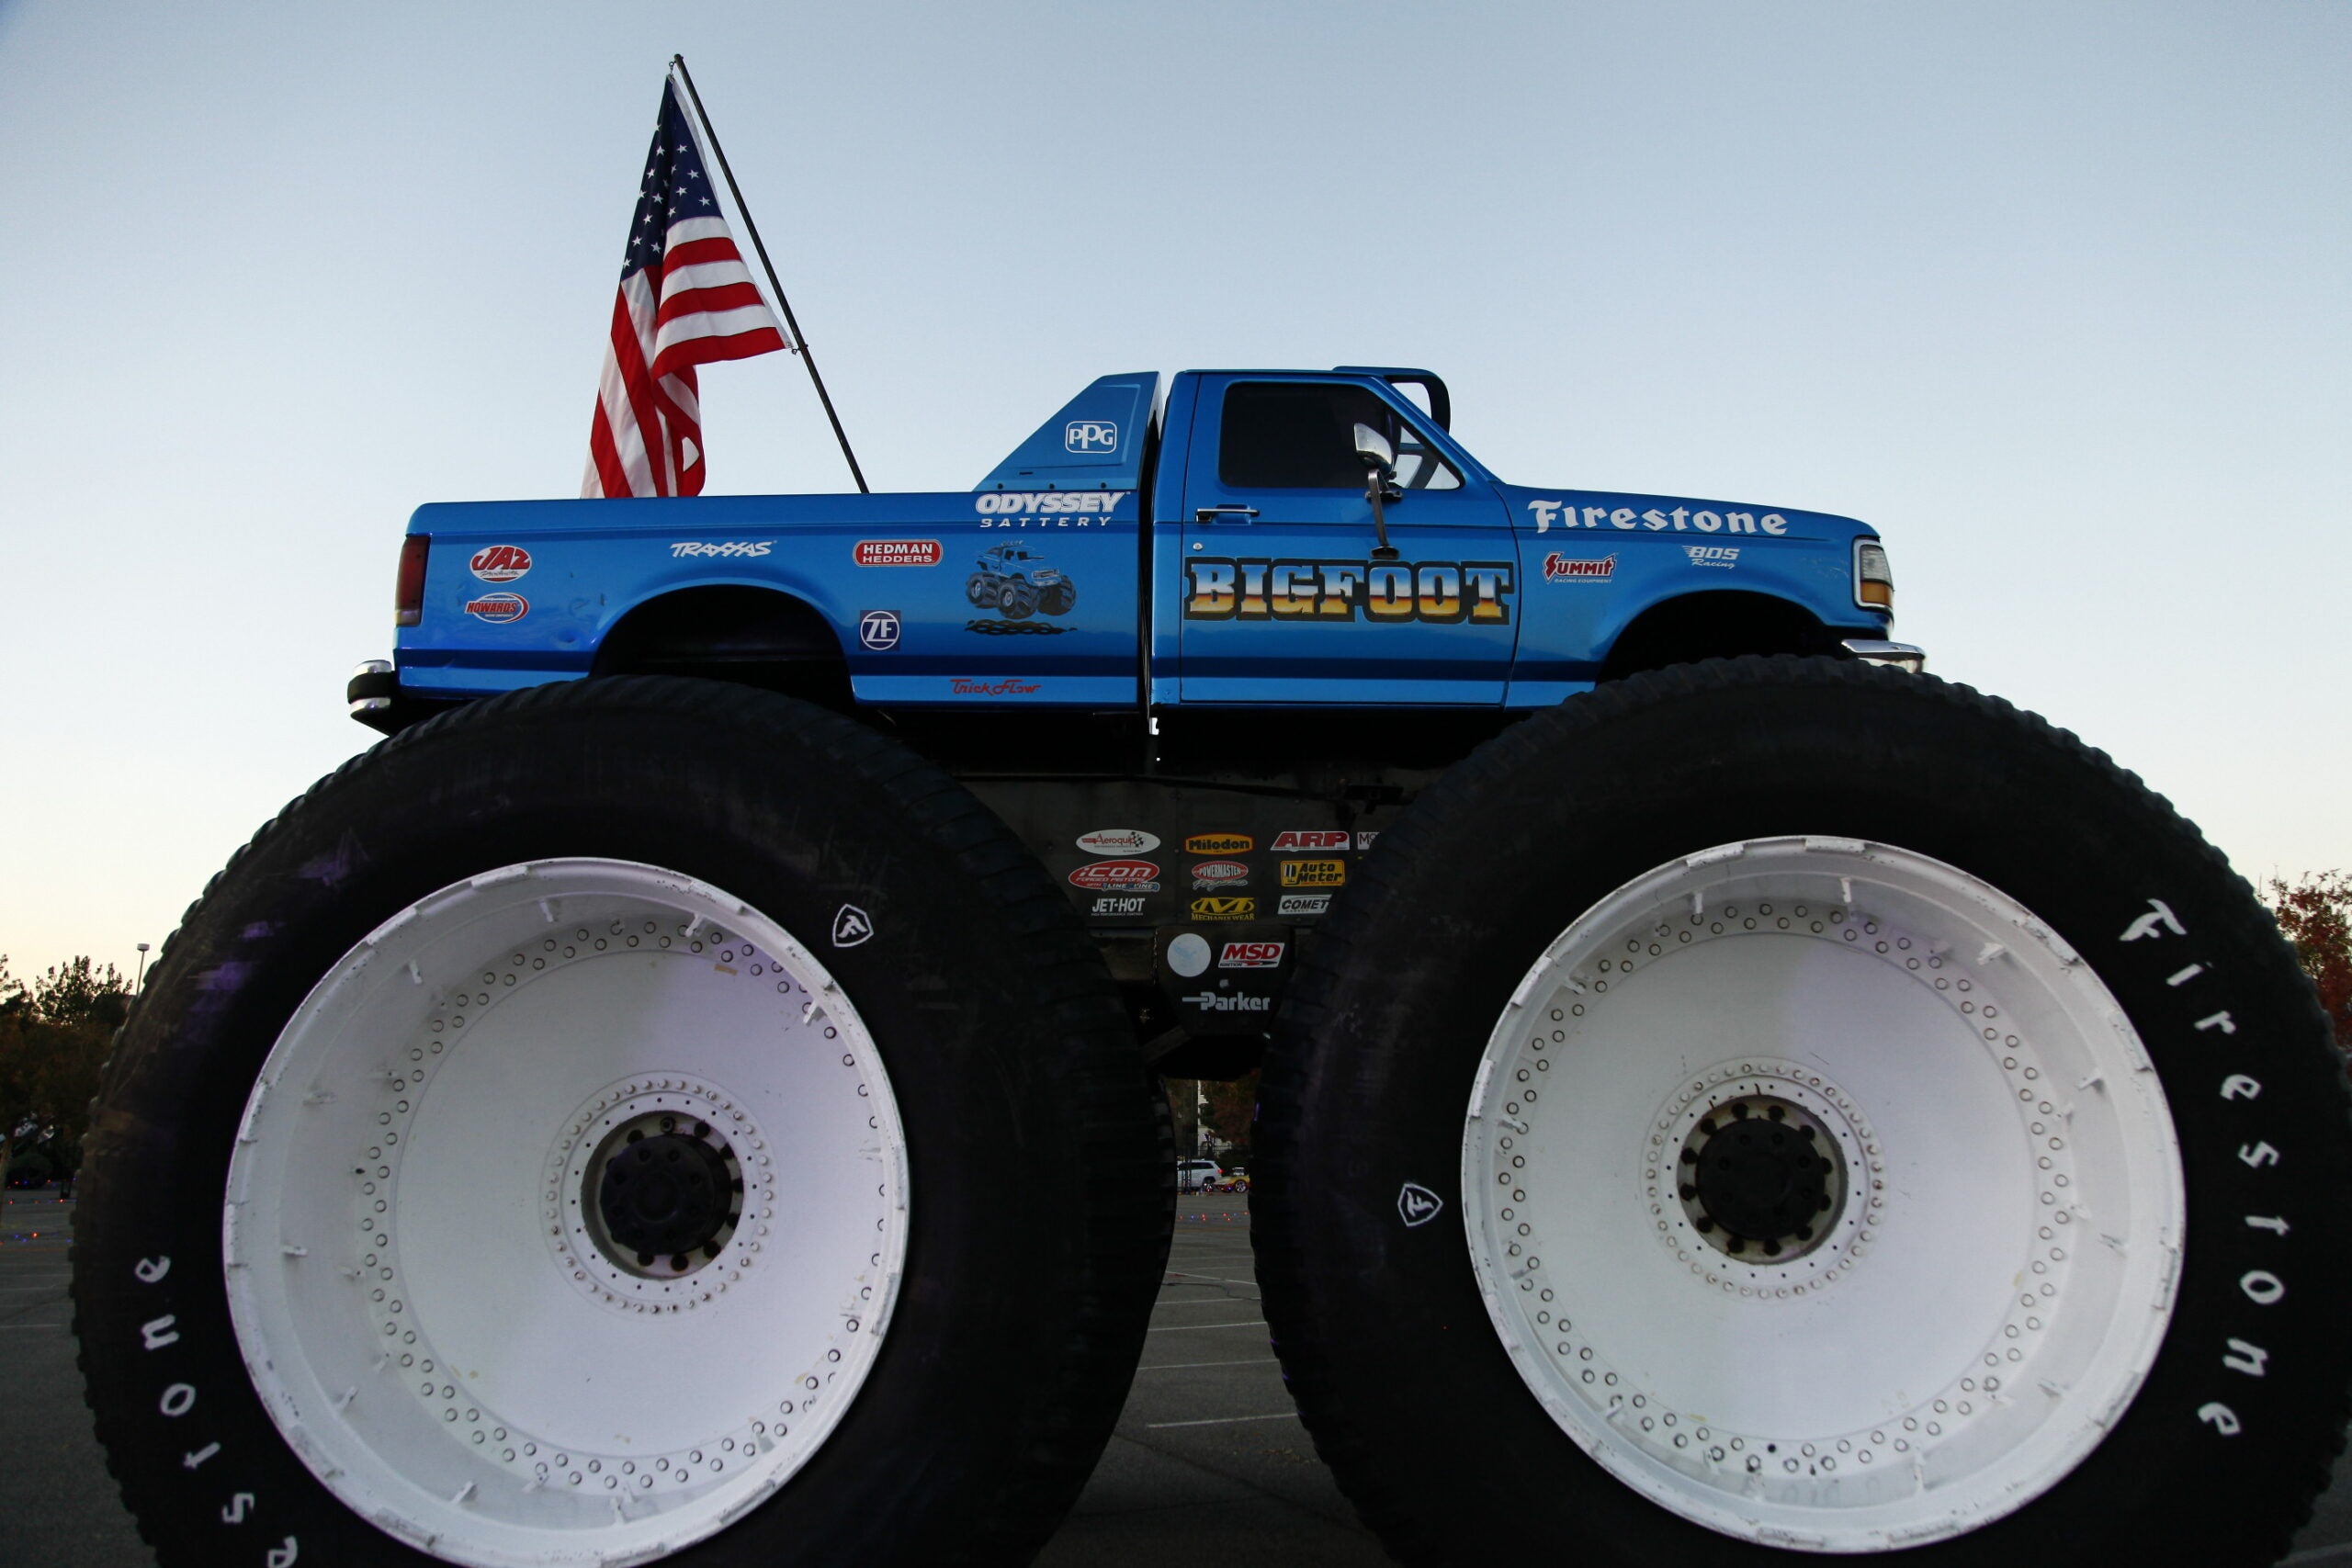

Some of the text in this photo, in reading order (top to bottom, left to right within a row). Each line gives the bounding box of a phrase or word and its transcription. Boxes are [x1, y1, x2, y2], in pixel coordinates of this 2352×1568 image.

[1069, 424, 1114, 449] PPG
[975, 491, 1125, 514] ODYSSEY
[1527, 500, 1788, 535] Firestone
[670, 541, 773, 558] TRAXXAS
[863, 543, 933, 555] HEDMAN
[471, 546, 531, 570] JAZ
[862, 555, 933, 564] HEDDERS
[1690, 558, 1736, 570] Racing
[1185, 558, 1514, 625] BIGFOOT
[467, 602, 517, 613] HOWARDS
[865, 618, 895, 641] ZF
[950, 678, 1041, 696] Trick Flow
[1095, 832, 1136, 846] Aeroquip
[1189, 839, 1250, 851] Milodon
[1273, 832, 1348, 847] ARP
[1299, 863, 1336, 873] Auto
[1296, 872, 1342, 883] Meter
[1091, 897, 1146, 912] JET-HOT
[1281, 899, 1331, 909] COMET
[1223, 943, 1281, 960] MSD
[1199, 991, 1272, 1010] Parker
[2119, 897, 2290, 1437] Firestone
